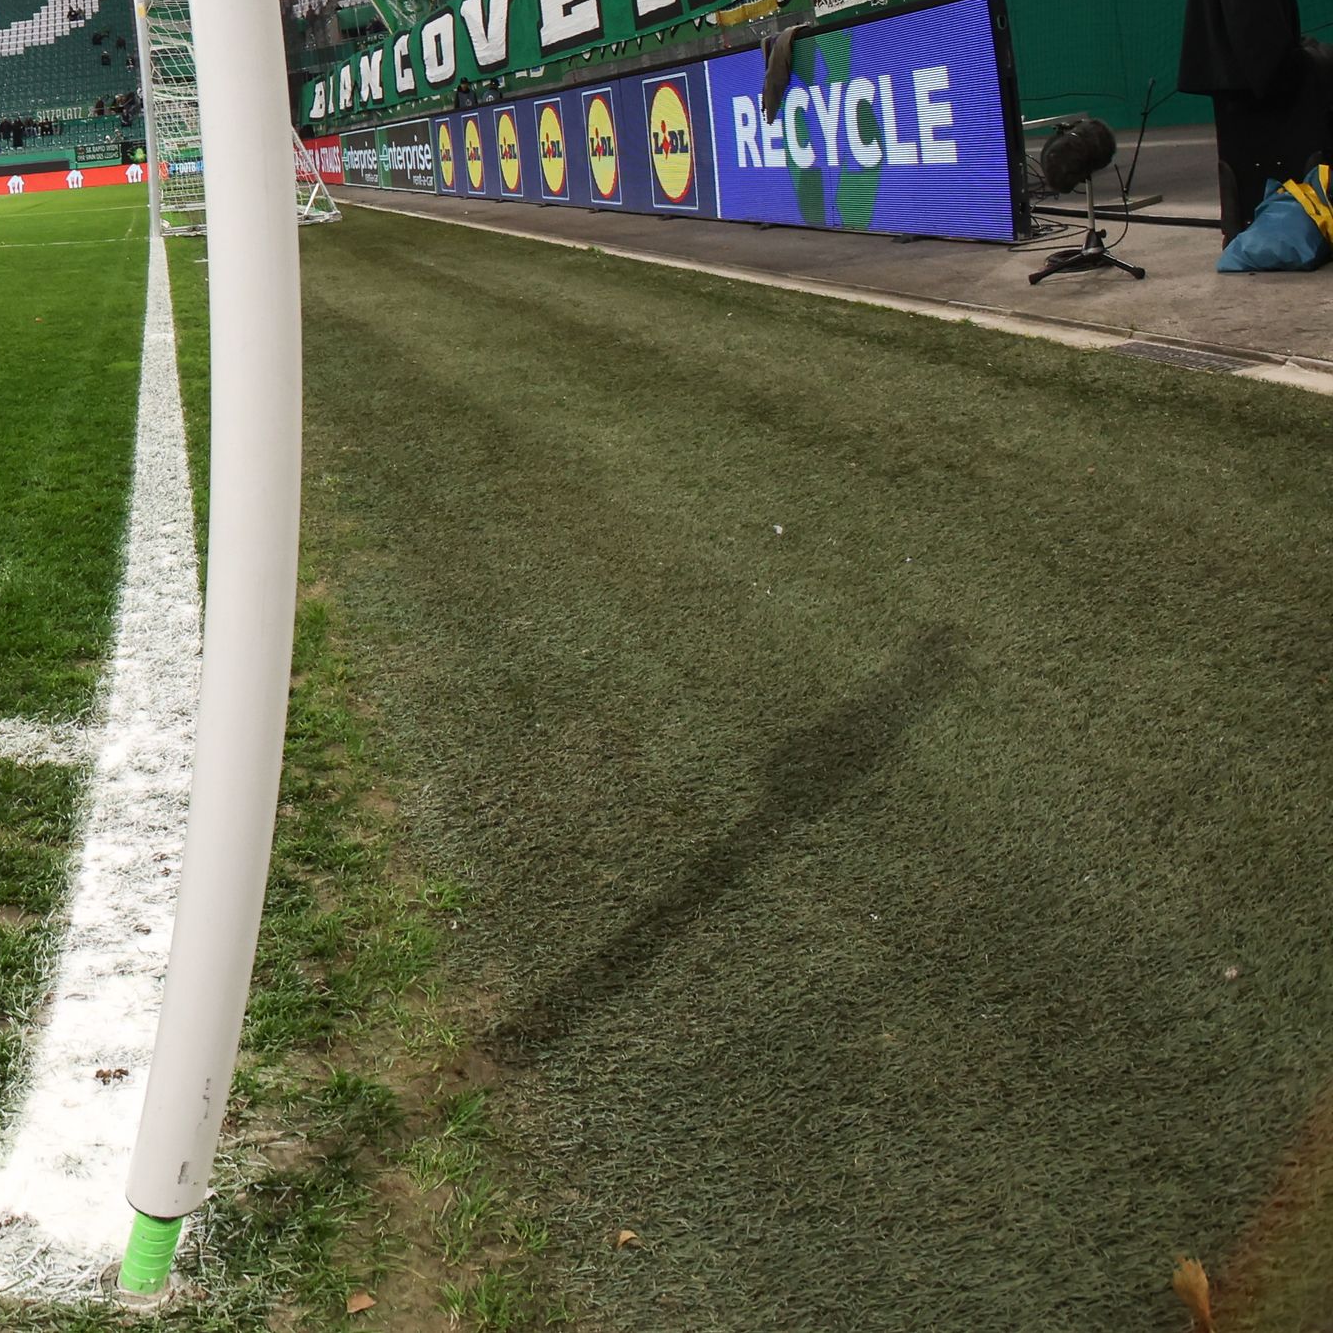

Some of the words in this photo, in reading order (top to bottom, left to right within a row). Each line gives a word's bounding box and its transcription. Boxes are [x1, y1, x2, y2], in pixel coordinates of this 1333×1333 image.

[36, 107, 83, 123] SITZPLATZ
[732, 65, 958, 168] RECYCLE
[379, 134, 432, 180] enterprise
[653, 121, 689, 158] LIDL
[342, 141, 378, 177] enterprise
